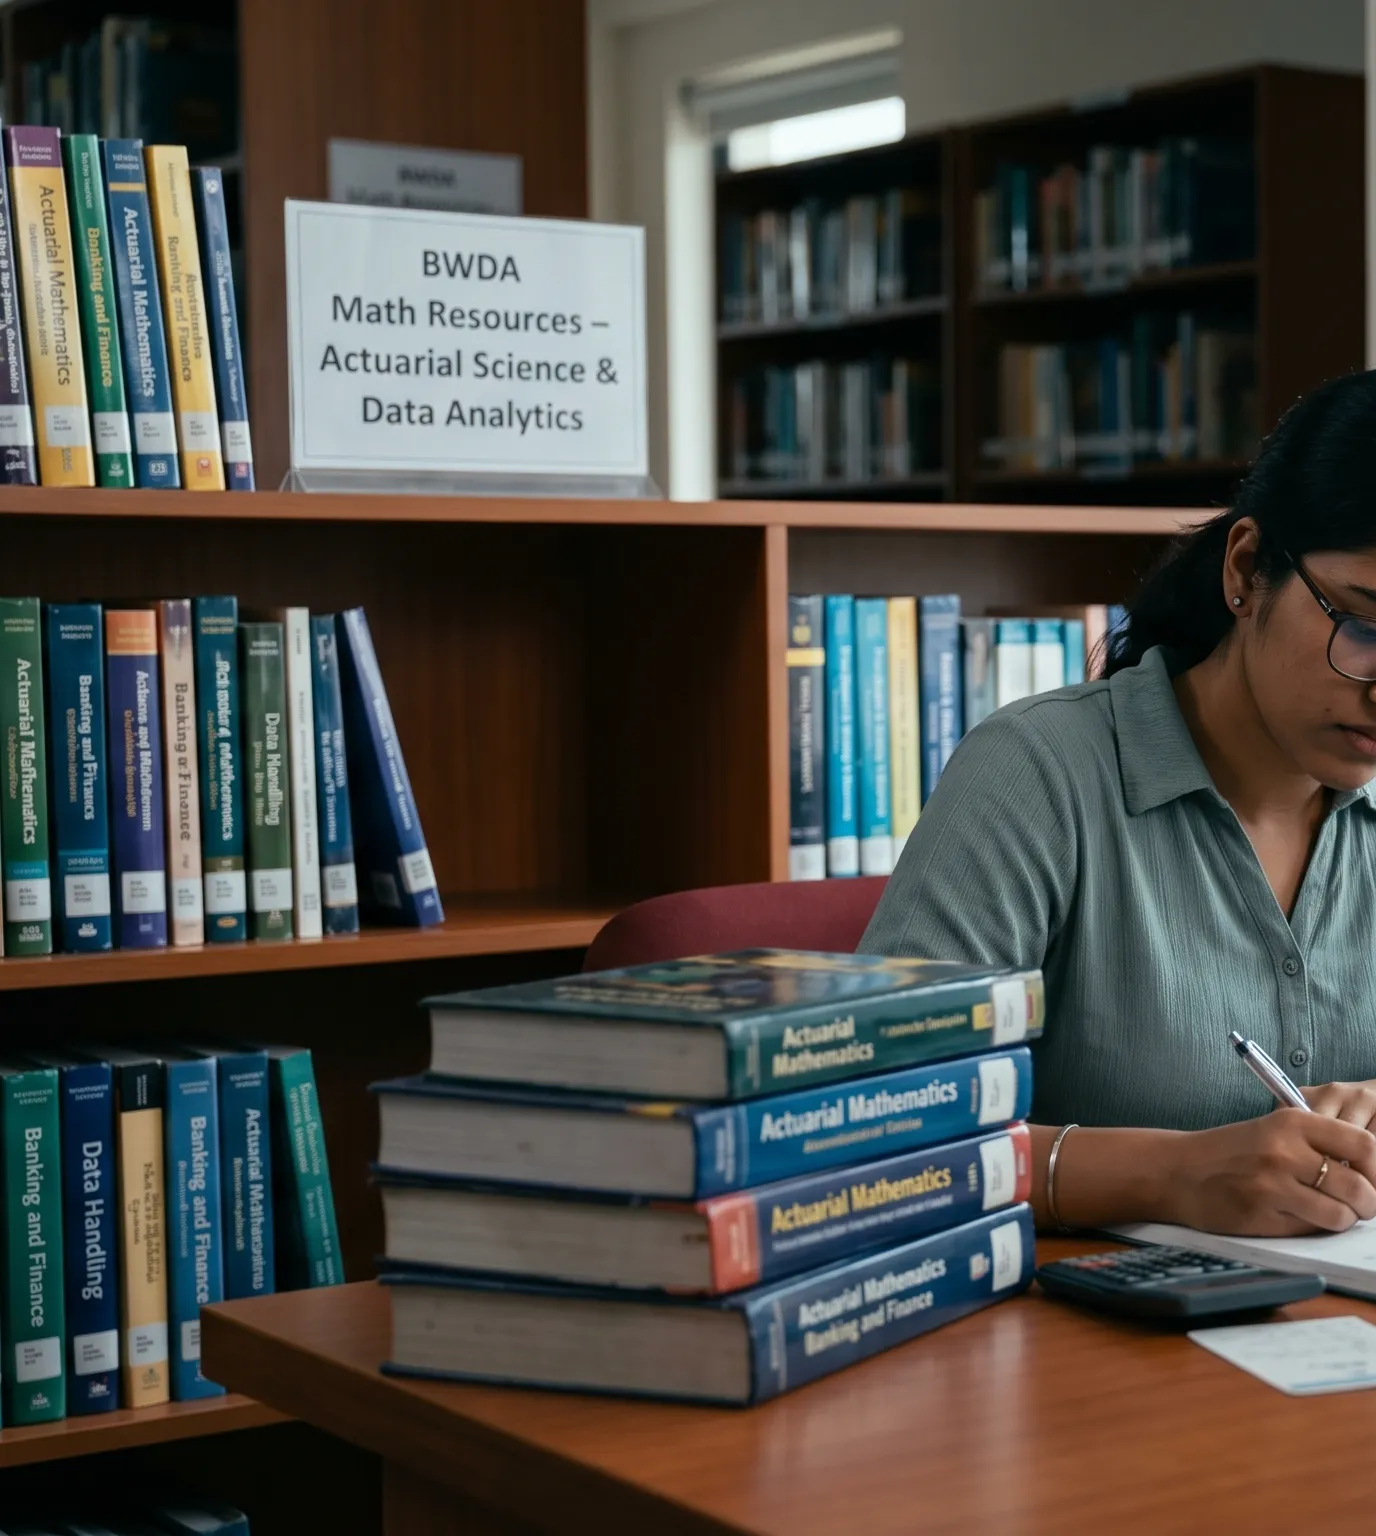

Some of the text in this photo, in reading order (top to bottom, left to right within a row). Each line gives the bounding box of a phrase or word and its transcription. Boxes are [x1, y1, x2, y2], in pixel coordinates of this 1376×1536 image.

[422, 250, 521, 283] BWDA
[49, 270, 71, 386] Mathematics
[331, 294, 416, 326] Math
[428, 300, 582, 335] Resources
[320, 344, 619, 385] Actuarial Science &
[362, 396, 583, 436] Data Analytics
[175, 683, 188, 756] Banking
[773, 1042, 874, 1079] Mathematics
[782, 1016, 855, 1049] Actuarial
[760, 1097, 844, 1143] Actuarial
[848, 1078, 958, 1123] Mathematics
[22, 1126, 47, 1328] Banking and Finance
[82, 1140, 107, 1301] Data Handling
[188, 1115, 212, 1305] Banking and Finance
[771, 1165, 951, 1235] Actuarial Mathematics
[799, 1258, 947, 1329] Actuarial Mathematics
[861, 1305, 885, 1331] and
[887, 1290, 934, 1323] Finance
